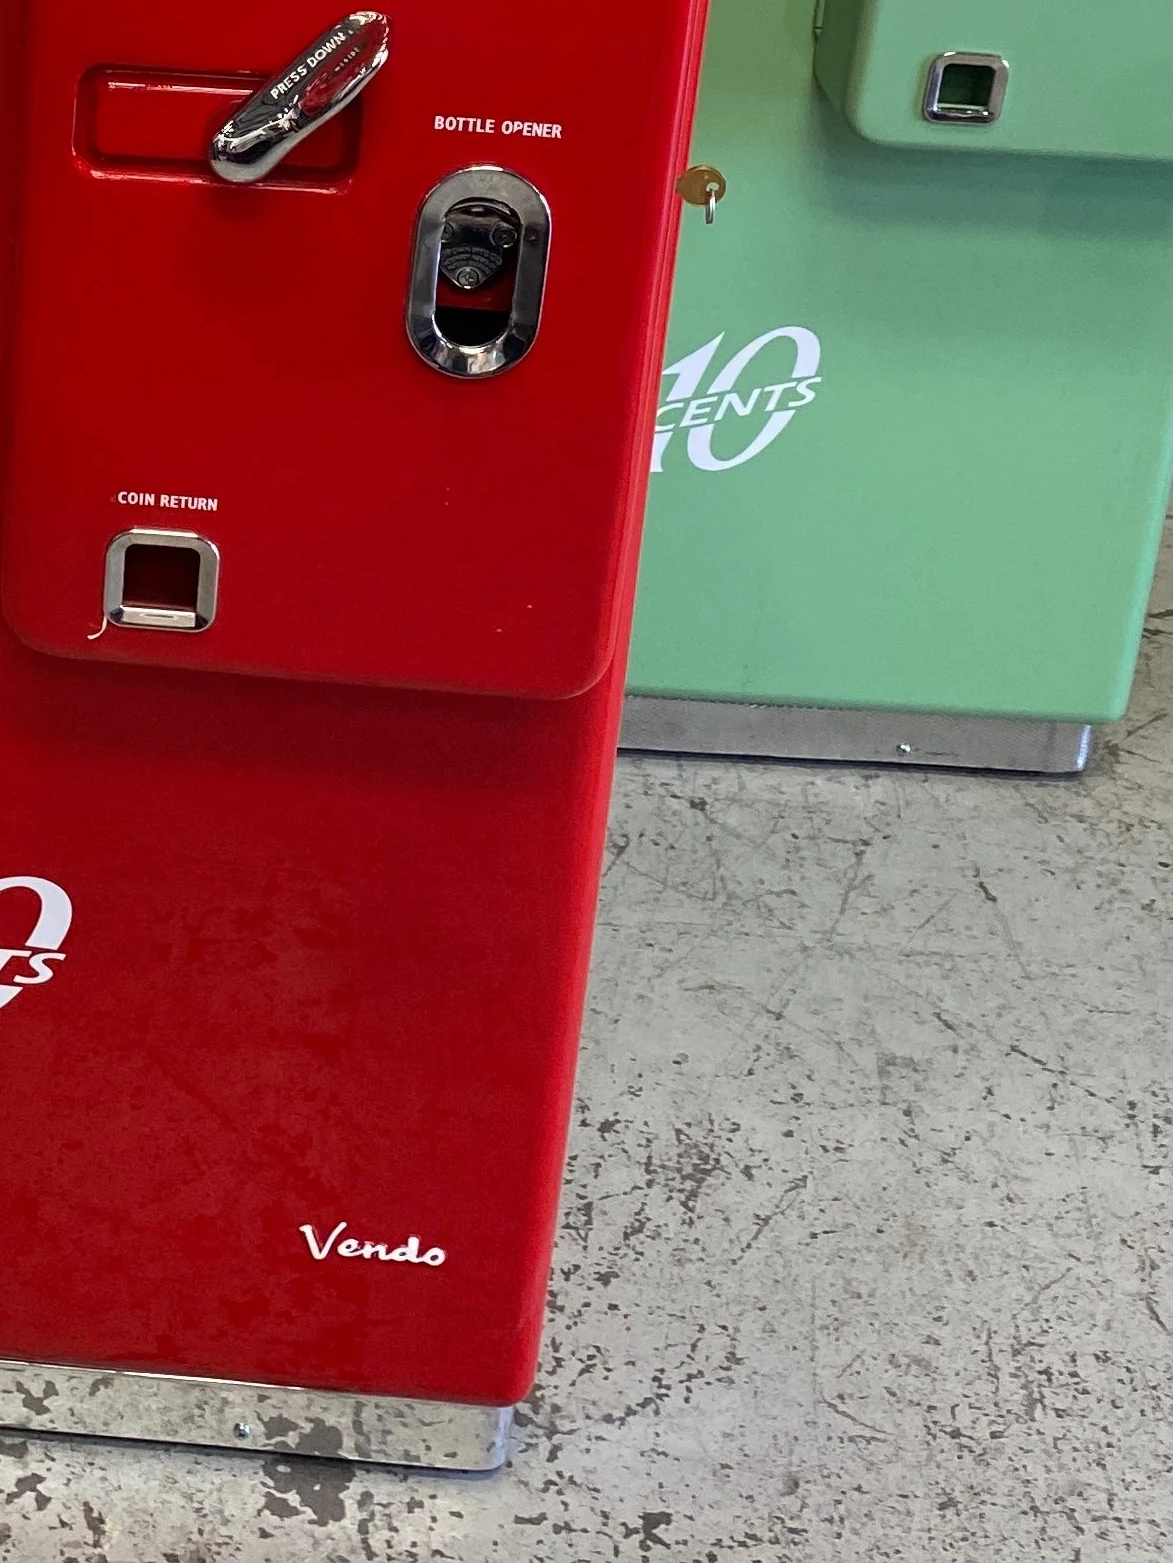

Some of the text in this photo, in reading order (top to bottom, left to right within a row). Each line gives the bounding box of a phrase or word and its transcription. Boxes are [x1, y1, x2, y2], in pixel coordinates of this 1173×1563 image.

[270, 63, 308, 100] PRESS
[306, 31, 346, 68] DOWN
[434, 115, 562, 139] BOTTLE OPENER
[650, 326, 821, 472] 10
[655, 377, 822, 431] CENTS
[117, 491, 218, 512] COIN RETURN
[298, 1221, 446, 1267] Vendo
